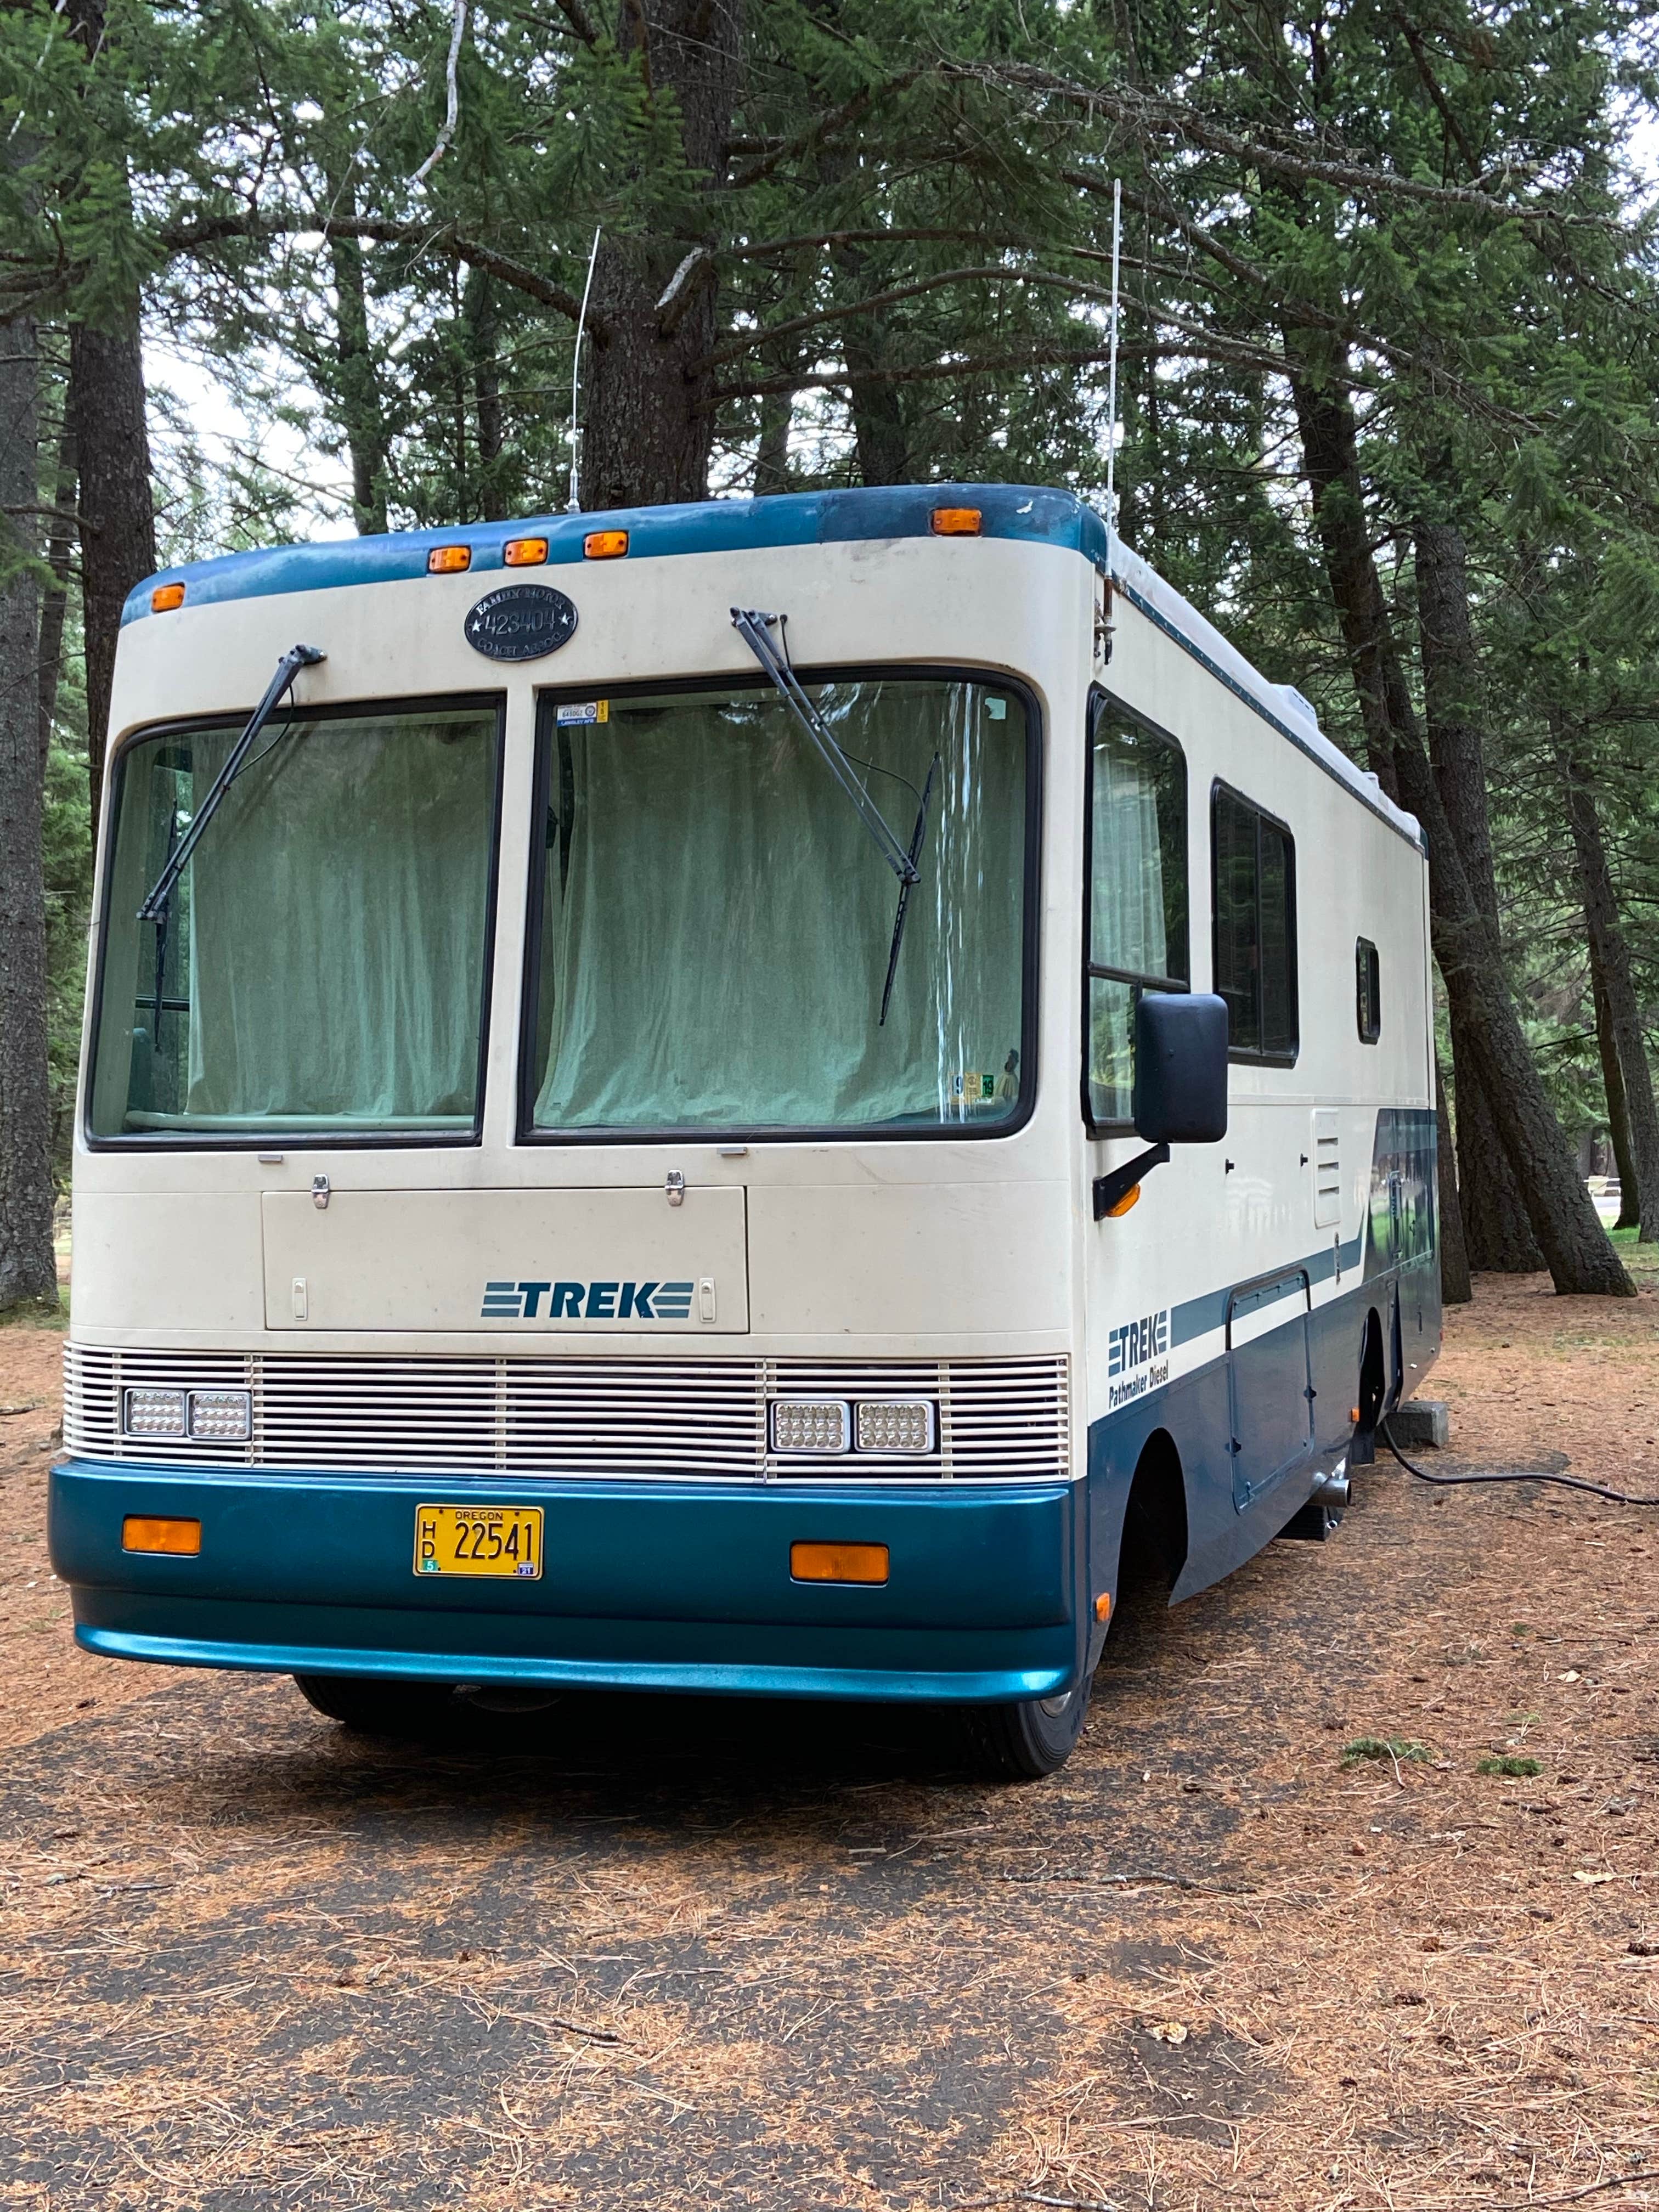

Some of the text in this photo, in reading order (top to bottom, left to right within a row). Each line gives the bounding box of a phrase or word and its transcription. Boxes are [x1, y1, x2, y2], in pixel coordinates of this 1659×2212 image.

[476, 588, 521, 616] FAMILY
[983, 1080, 994, 1095] 19
[517, 1282, 660, 1318] TREK
[1120, 1313, 1158, 1372] TREK
[1109, 1359, 1169, 1409] Pathmaker Diesel
[455, 1511, 503, 1520] OREGON
[454, 1521, 532, 1561] 22541
[427, 1561, 434, 1571] 5
